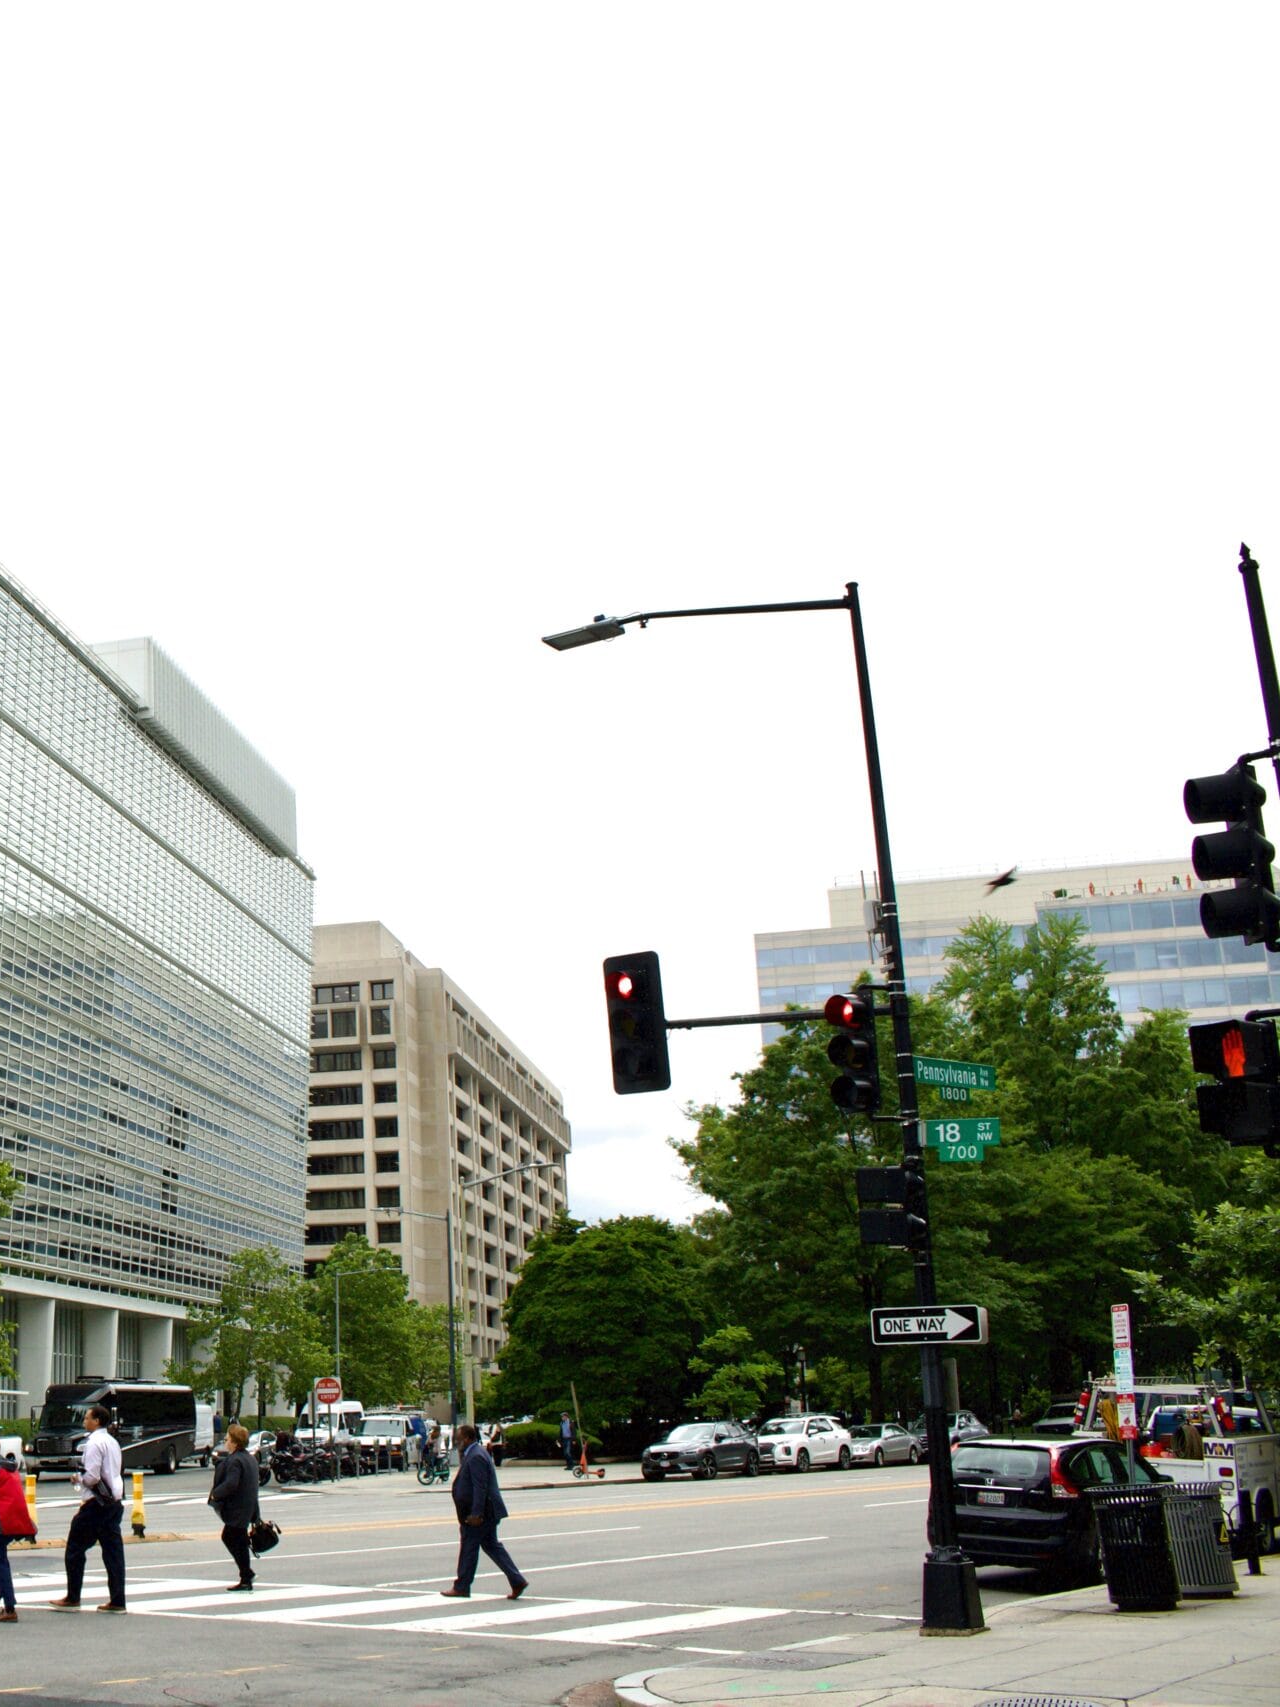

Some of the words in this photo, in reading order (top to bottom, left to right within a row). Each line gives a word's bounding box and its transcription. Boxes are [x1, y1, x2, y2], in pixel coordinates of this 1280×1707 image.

[917, 1060, 977, 1086] Pennsylvania
[942, 1087, 967, 1101] 1800
[934, 1123, 961, 1143] 18
[977, 1122, 991, 1131] ST
[977, 1132, 993, 1141] NW
[947, 1146, 977, 1159] 700
[883, 1319, 912, 1333] ONE
[916, 1317, 946, 1331] WAY
